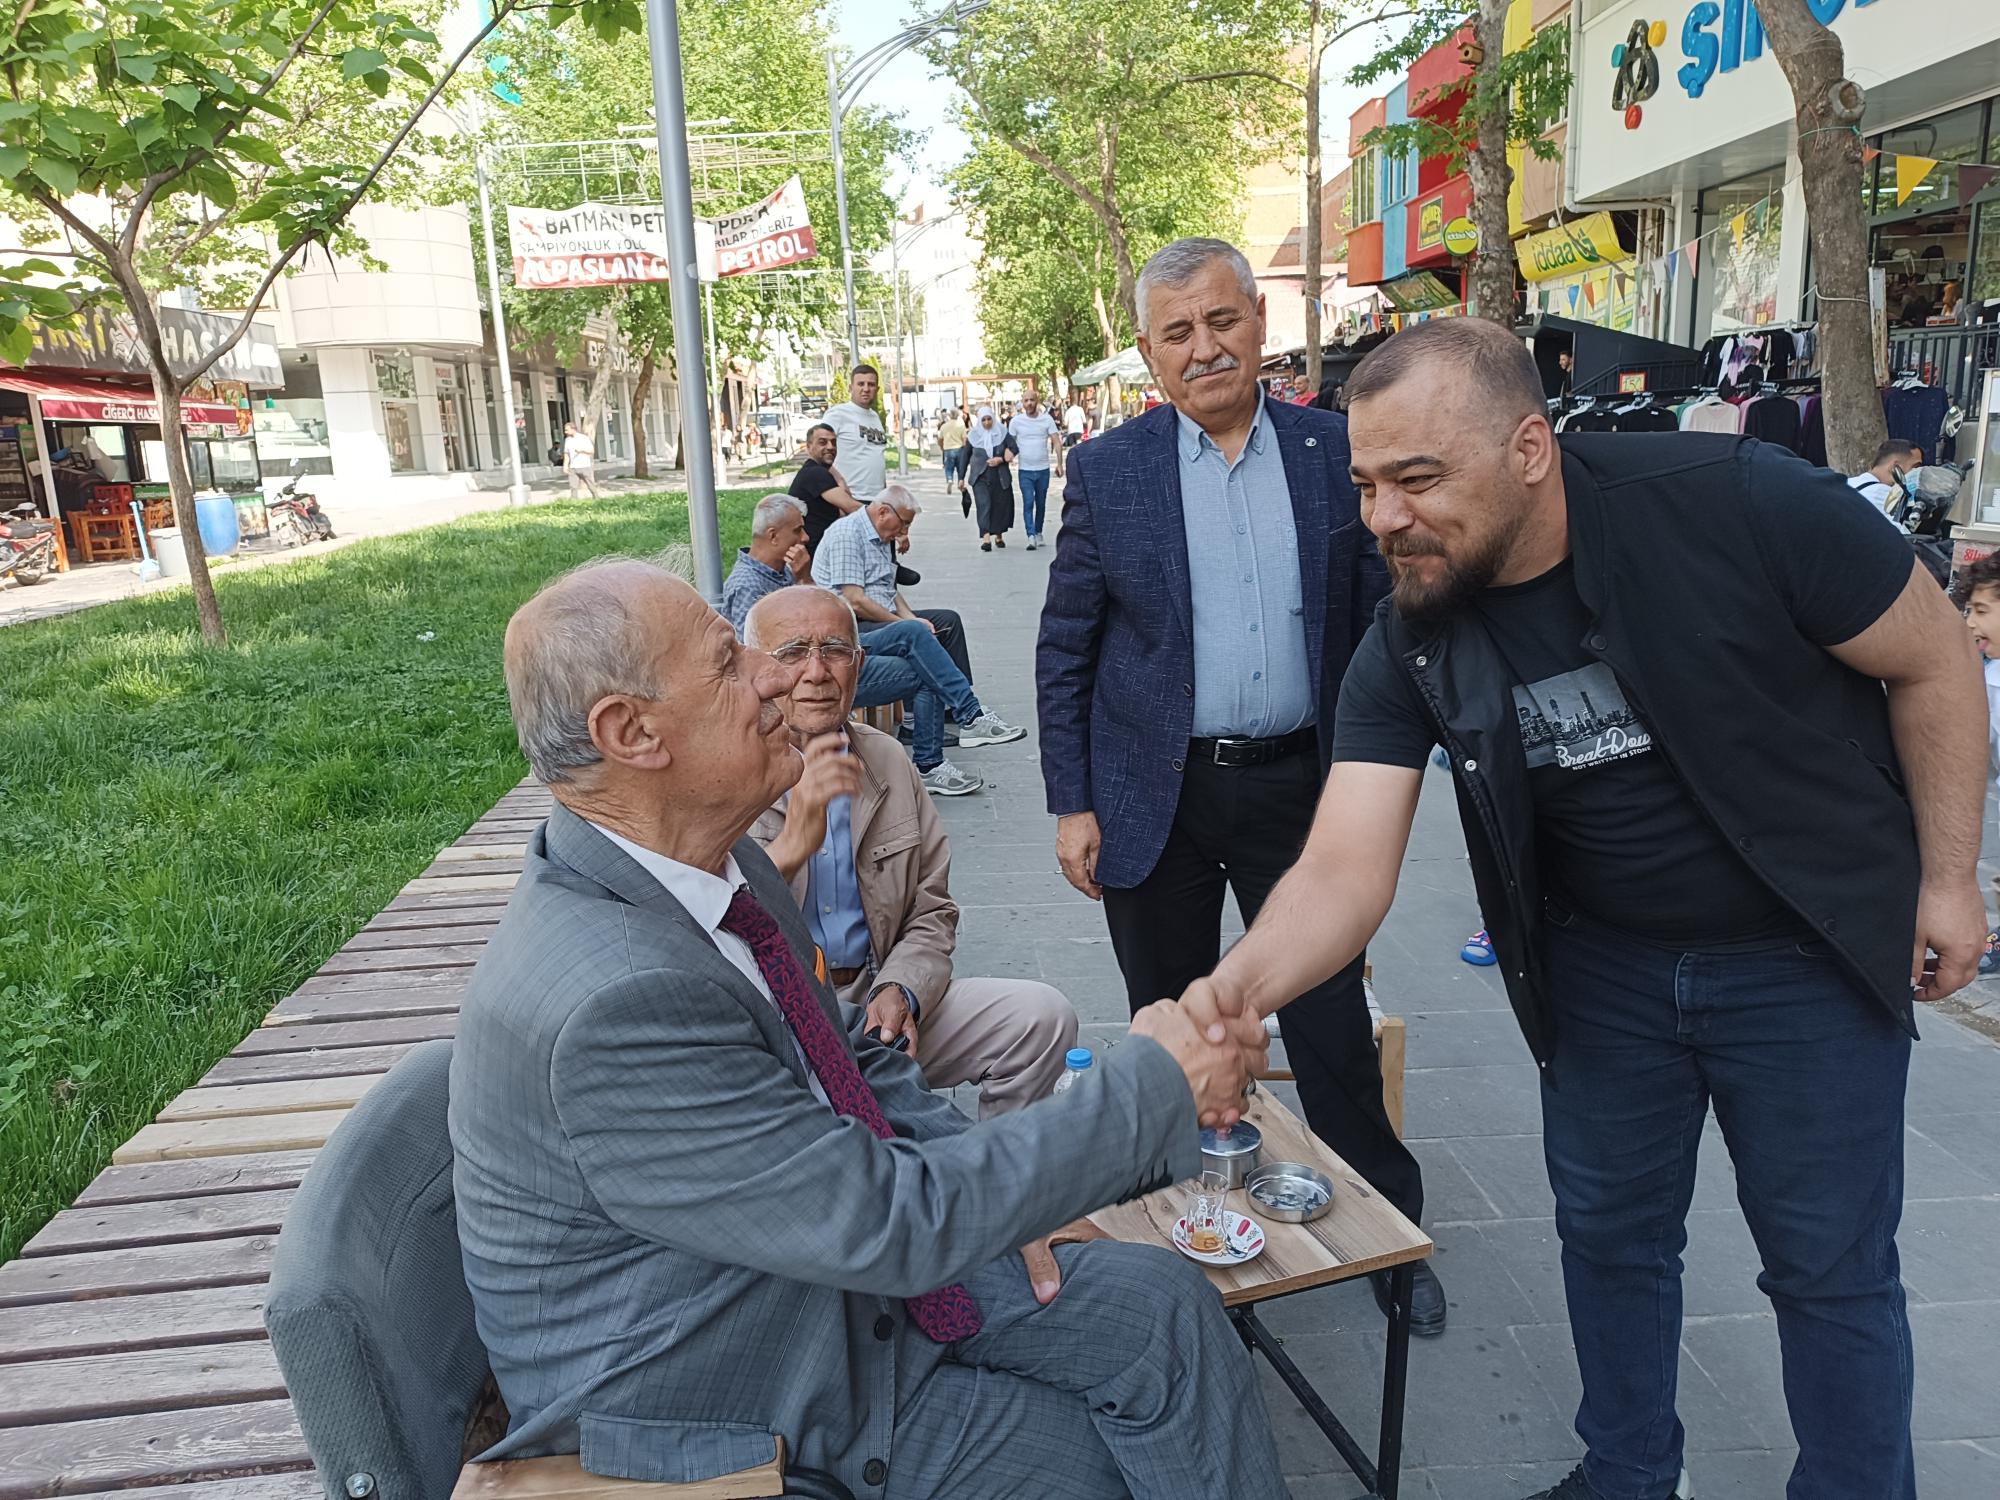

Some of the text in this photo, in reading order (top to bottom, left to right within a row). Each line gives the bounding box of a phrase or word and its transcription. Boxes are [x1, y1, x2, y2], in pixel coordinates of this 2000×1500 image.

[546, 211, 624, 234] BATMAN
[720, 232, 809, 273] PETROL
[1532, 239, 1576, 273] iddaa
[161, 326, 252, 370] HASAN
[1554, 737, 1607, 768] Break
